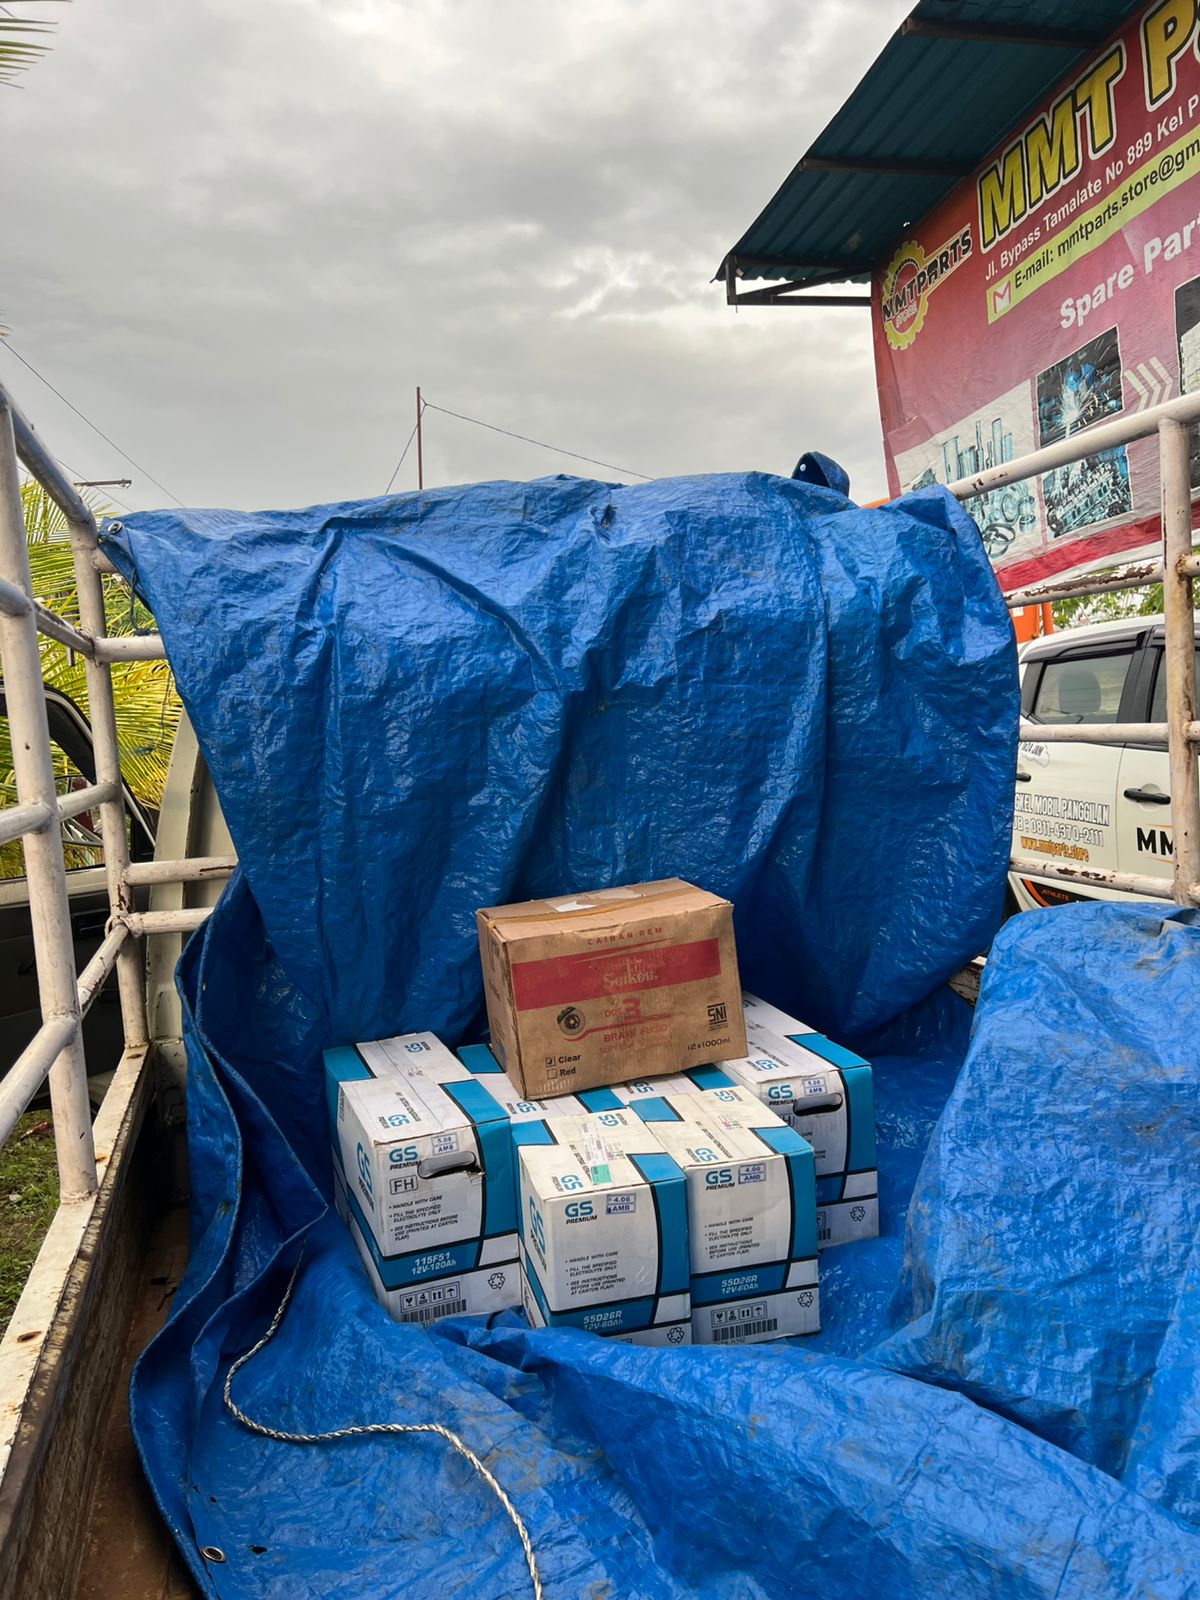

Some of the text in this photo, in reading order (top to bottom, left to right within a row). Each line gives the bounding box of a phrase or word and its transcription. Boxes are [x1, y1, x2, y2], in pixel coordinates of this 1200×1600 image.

[978, 0, 1200, 253] MMT P
[986, 94, 1199, 281] Jl. Bypass Tamalate No 889 Kel P
[1014, 138, 1200, 290] E-mail: mmtparts.store@gm
[882, 227, 972, 324] MMTPARTS
[1060, 211, 1200, 329] Spare Par
[895, 301, 917, 329] STORE
[1034, 794, 1060, 818] MOBIL
[1060, 798, 1110, 827] PANGGILAN
[1030, 818, 1104, 847] 0811-4370-2111
[587, 931, 634, 945] CAIRAN
[623, 997, 641, 1026] 3
[707, 1004, 728, 1023] SNI
[558, 1053, 582, 1064] Clear
[755, 1060, 779, 1070] GS
[560, 1067, 576, 1077] Red
[768, 1085, 793, 1099] GS
[768, 1097, 798, 1106] PREMIUM
[388, 1114, 410, 1127] GS
[598, 1114, 619, 1127] GS
[388, 1145, 418, 1163] GS
[694, 1148, 719, 1162] GS
[357, 1141, 373, 1195] GS
[389, 1160, 422, 1171] PREMIUM
[560, 1174, 584, 1190] GS
[705, 1168, 733, 1185] GS
[393, 1177, 415, 1192] FH
[705, 1182, 735, 1191] PREMIUM
[393, 1201, 413, 1209] HANDLE
[416, 1204, 441, 1213] SPECIFIED
[564, 1200, 594, 1218] GS
[404, 1218, 439, 1229] INSTRUCTIONS
[438, 1219, 458, 1228] CARTON
[529, 1196, 546, 1255] GS
[565, 1214, 598, 1225] PREMIUM
[415, 1251, 451, 1266] 115F51
[569, 1255, 589, 1263] HANDLE
[592, 1260, 617, 1268] SPECIFIED
[411, 1259, 457, 1275] 12V-120Ah
[569, 1267, 602, 1277] ELECTROLYTE
[581, 1274, 617, 1283] INSTRUCTIONS
[721, 1274, 758, 1288] 55D26R
[583, 1310, 622, 1324] 55D26R
